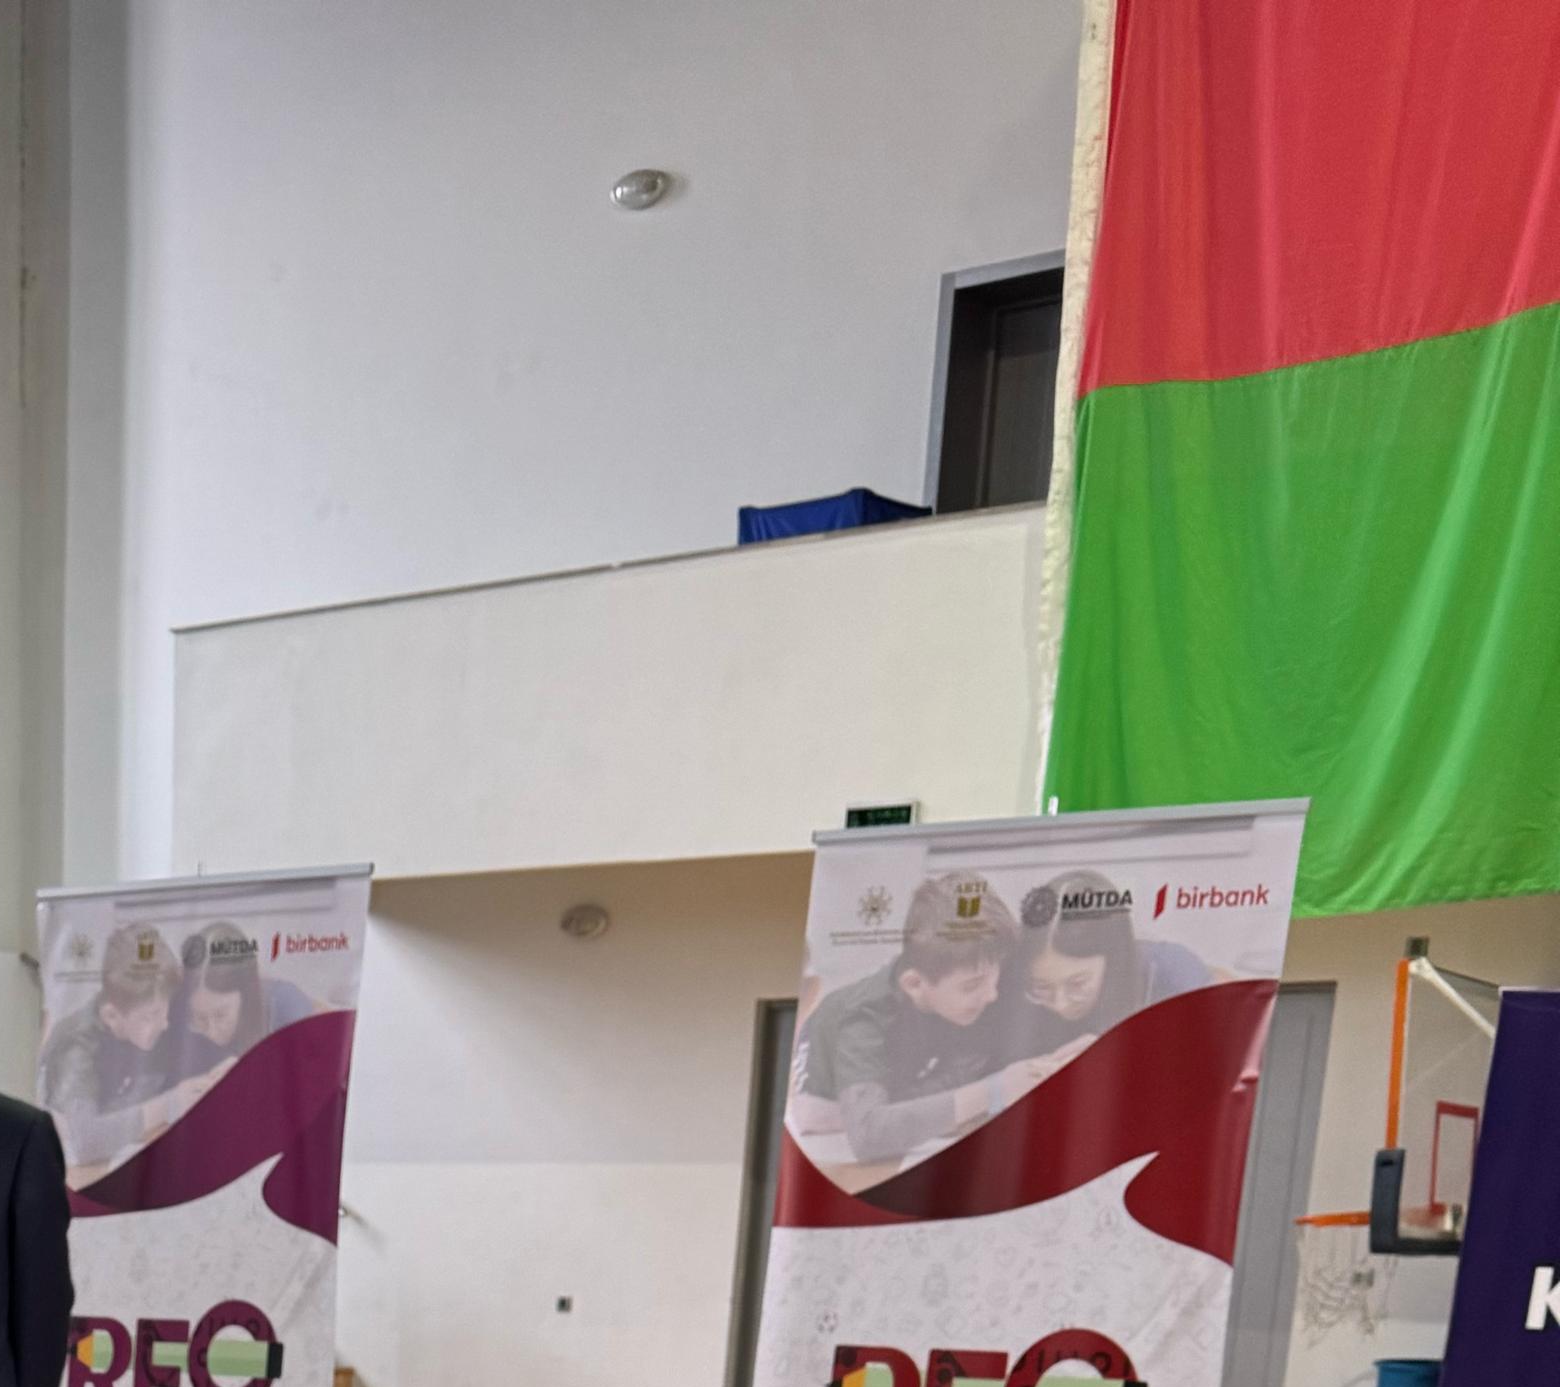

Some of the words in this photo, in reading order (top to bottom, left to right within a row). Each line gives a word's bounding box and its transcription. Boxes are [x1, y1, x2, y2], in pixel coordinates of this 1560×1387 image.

[1061, 889, 1133, 910] MÜTDA
[1175, 884, 1269, 909] birbank
[286, 932, 349, 953] birbank
